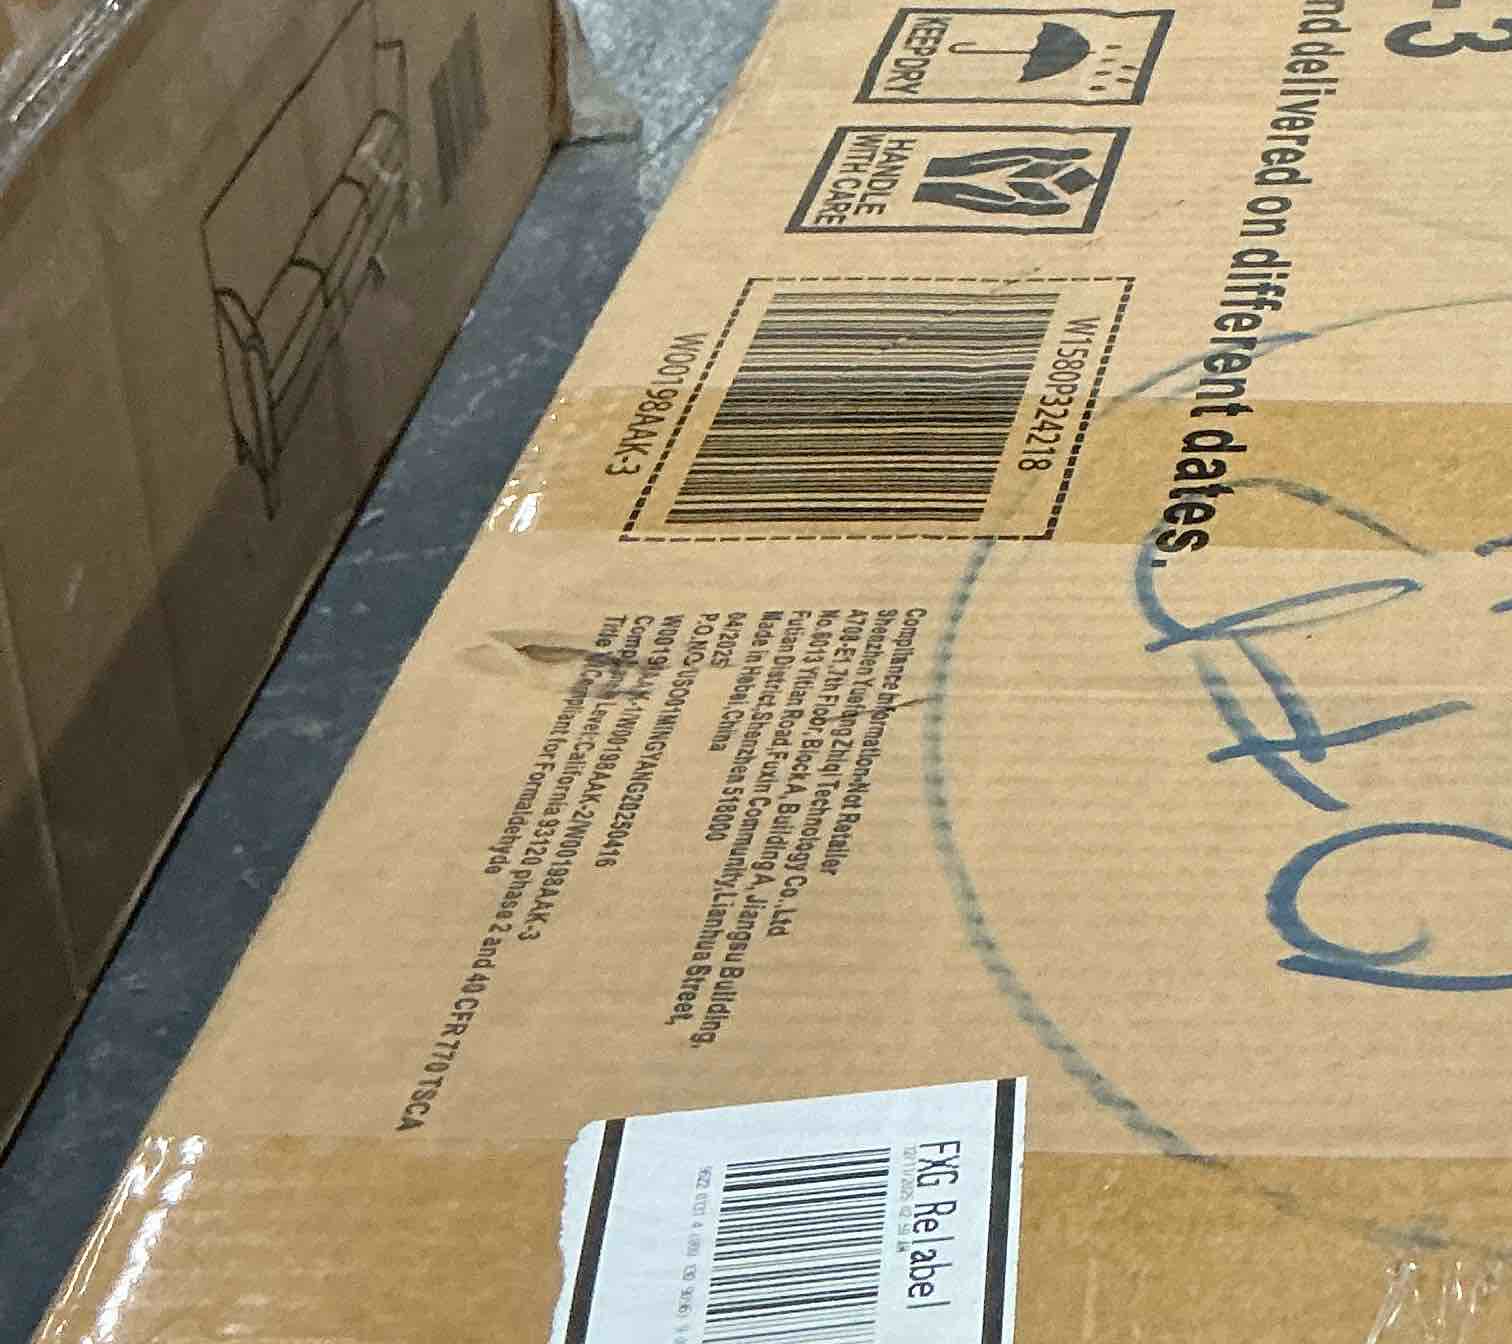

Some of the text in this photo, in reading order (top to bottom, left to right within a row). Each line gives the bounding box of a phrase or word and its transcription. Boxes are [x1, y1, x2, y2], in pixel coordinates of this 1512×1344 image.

[883, 14, 951, 97] KEEP DRY
[1255, 42, 1345, 186] delivered
[813, 133, 888, 226] WITH CARE
[852, 138, 919, 217] HANDLE
[1240, 195, 1292, 238] on
[1190, 249, 1292, 417] different
[605, 333, 709, 476] W00198AAK-3
[1018, 317, 1101, 471] W1580P324218
[1152, 429, 1247, 568] dates.
[746, 650, 768, 663] in
[751, 610, 784, 647] Made
[855, 609, 898, 676] Shenzhen
[882, 608, 928, 690] Compliance
[521, 818, 557, 866] 93120
[784, 780, 840, 873] Technology
[820, 813, 862, 876] Retailer
[495, 869, 533, 920] phase
[472, 937, 501, 969] and
[488, 923, 512, 934] 2
[440, 998, 479, 1038] CFR
[424, 1040, 461, 1073] 770
[396, 1076, 443, 1132] TSCA
[905, 1141, 960, 1309] FXG Relabel
